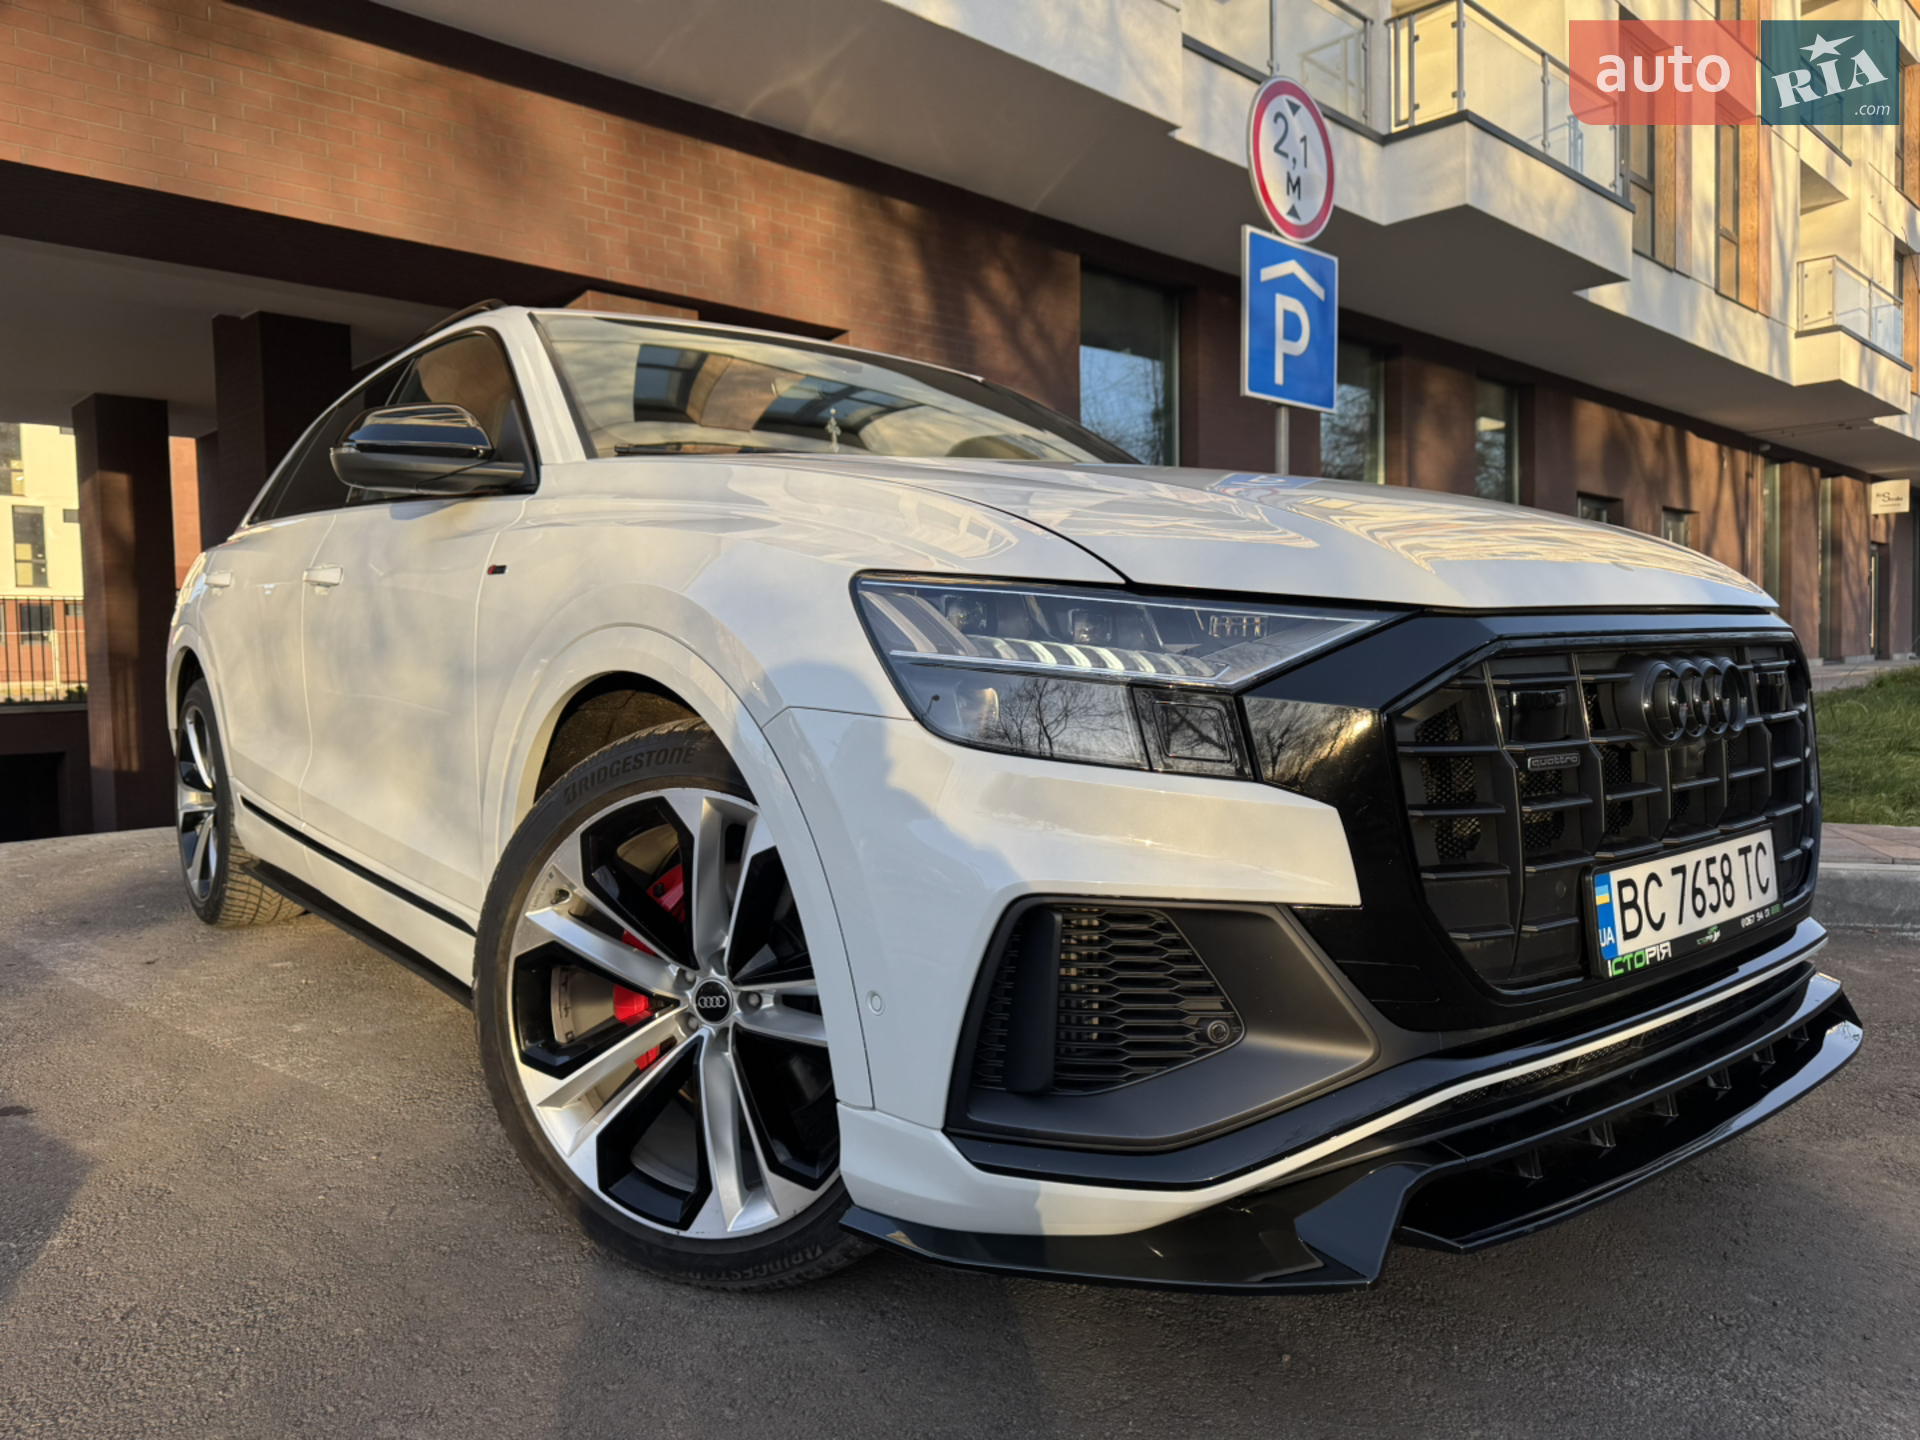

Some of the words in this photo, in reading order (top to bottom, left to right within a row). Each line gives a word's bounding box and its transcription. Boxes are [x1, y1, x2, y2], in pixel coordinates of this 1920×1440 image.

[1274, 293, 1311, 386] P
[563, 747, 694, 806] BRIDGESTONE
[1532, 755, 1578, 768] quattro
[1617, 872, 1666, 941] BC
[1671, 853, 1735, 925] 7658
[1738, 842, 1770, 900] TC
[1599, 926, 1615, 947] UA
